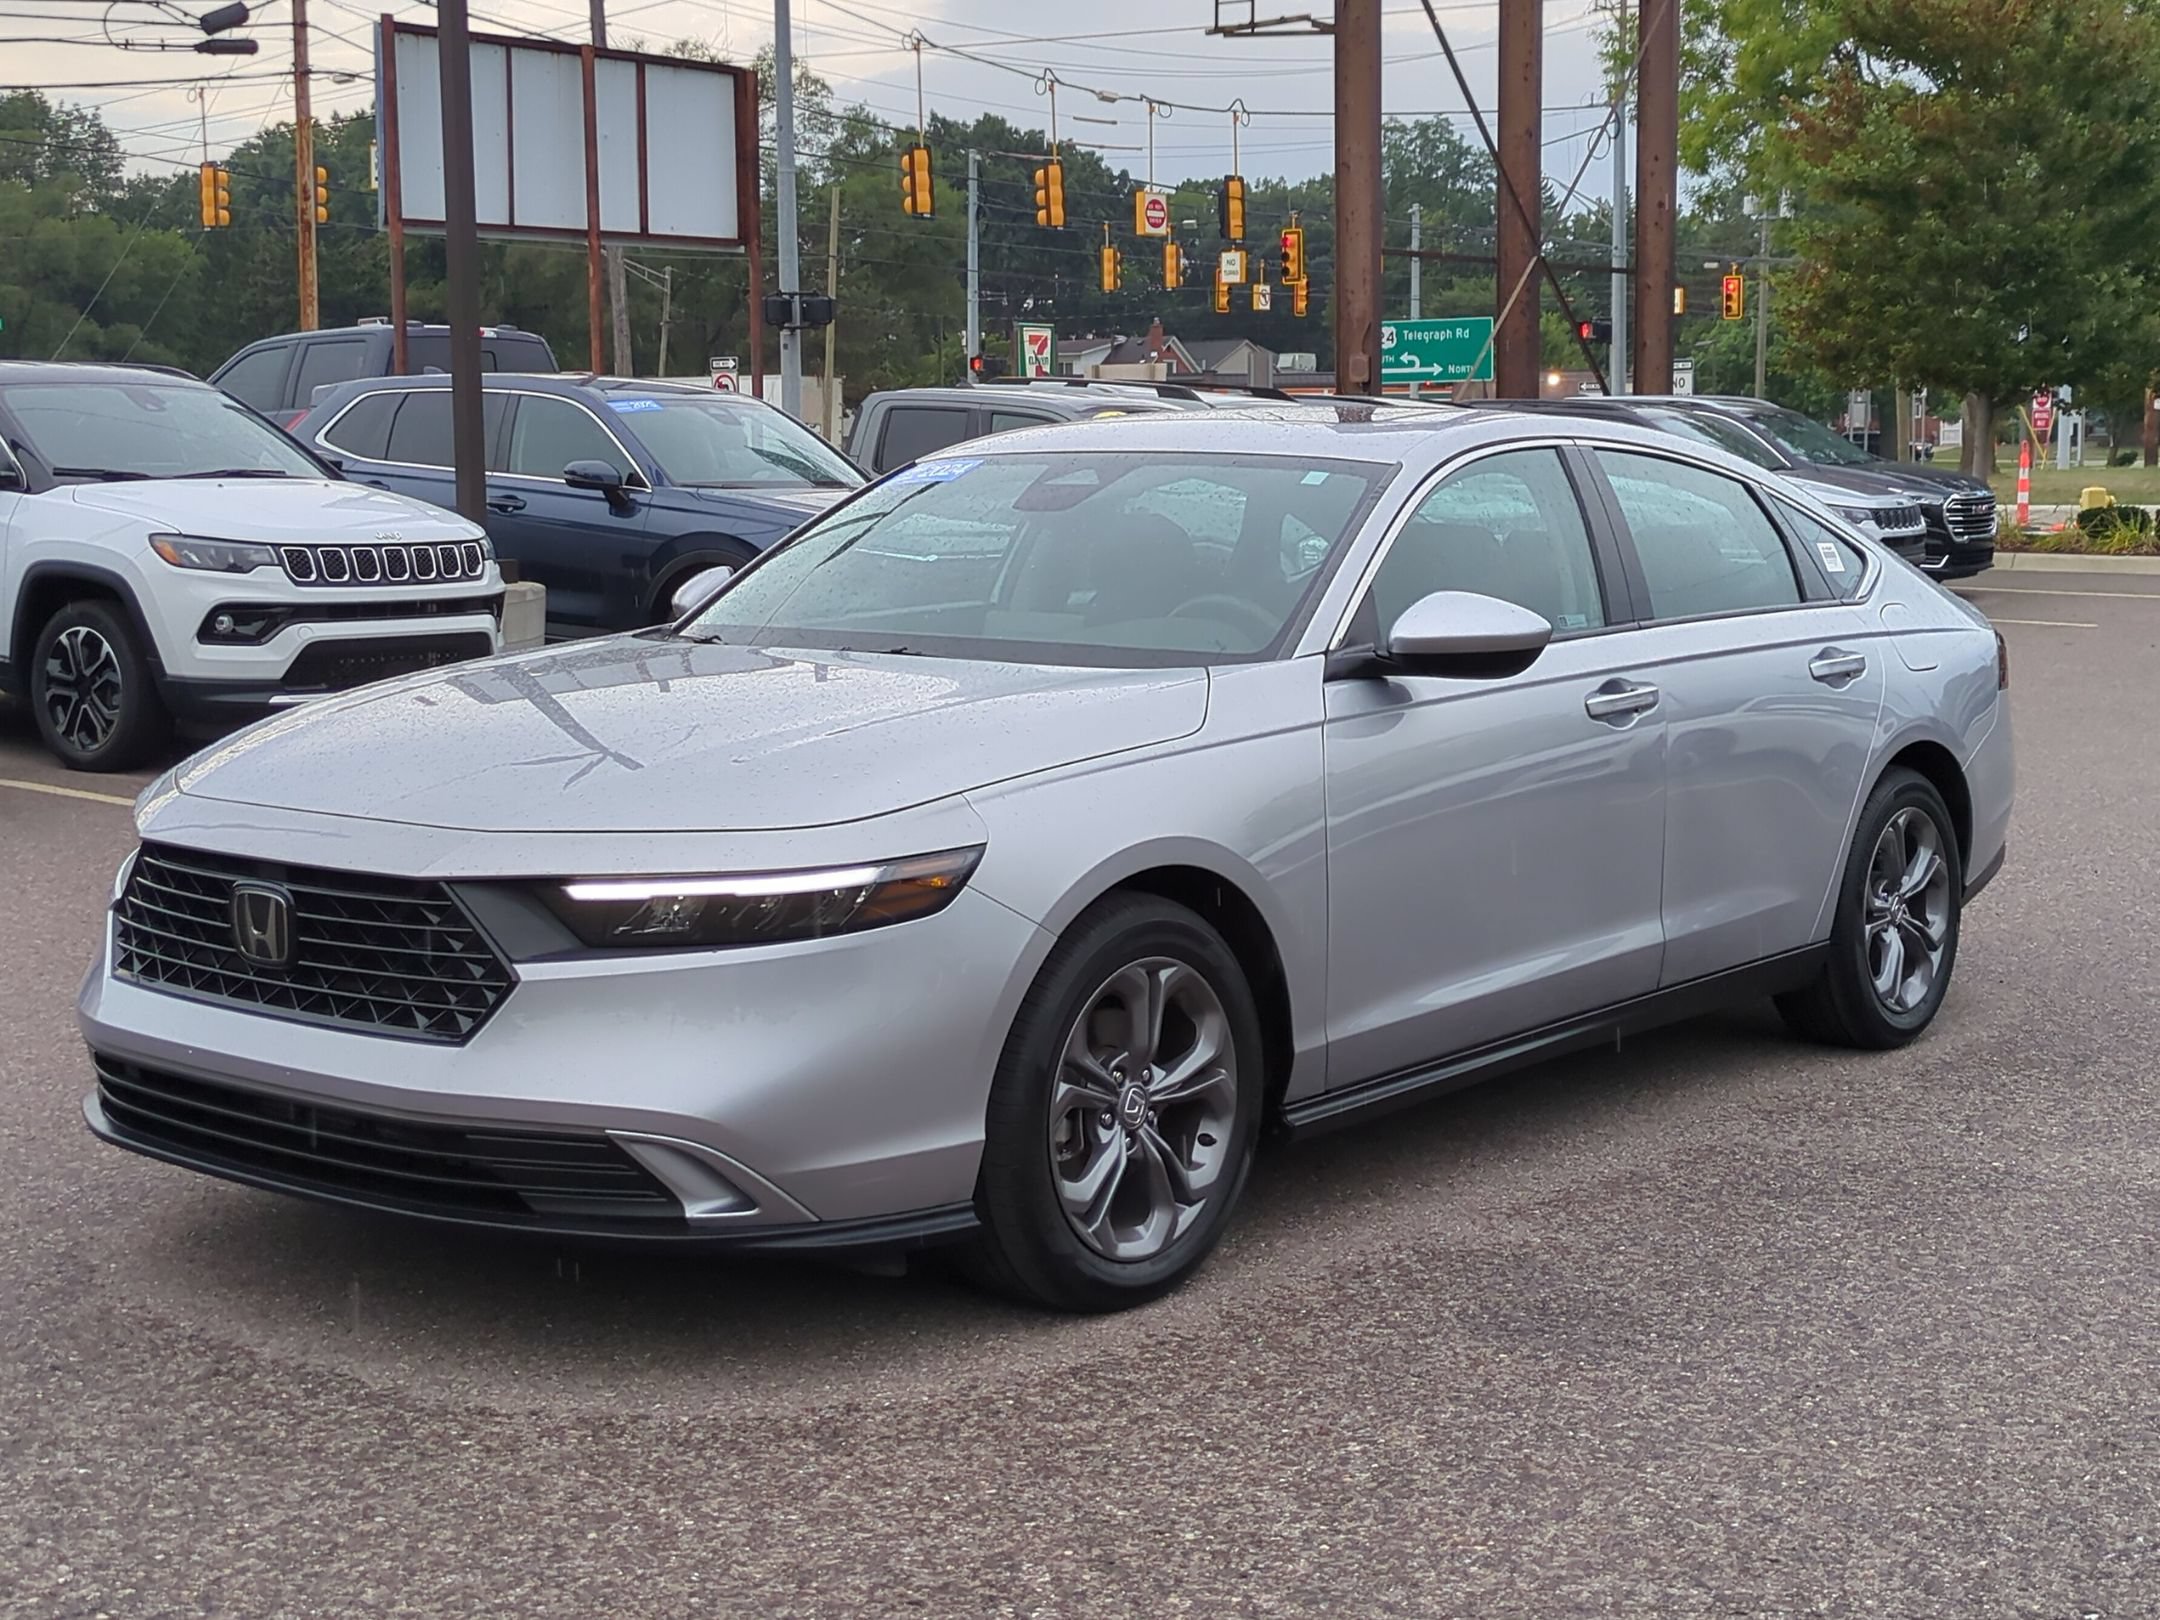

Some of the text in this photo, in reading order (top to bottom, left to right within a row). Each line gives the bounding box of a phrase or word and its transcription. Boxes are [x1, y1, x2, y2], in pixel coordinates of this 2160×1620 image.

[1403, 327, 1470, 344] Telegraph Rd
[1028, 334, 1049, 378] 7
